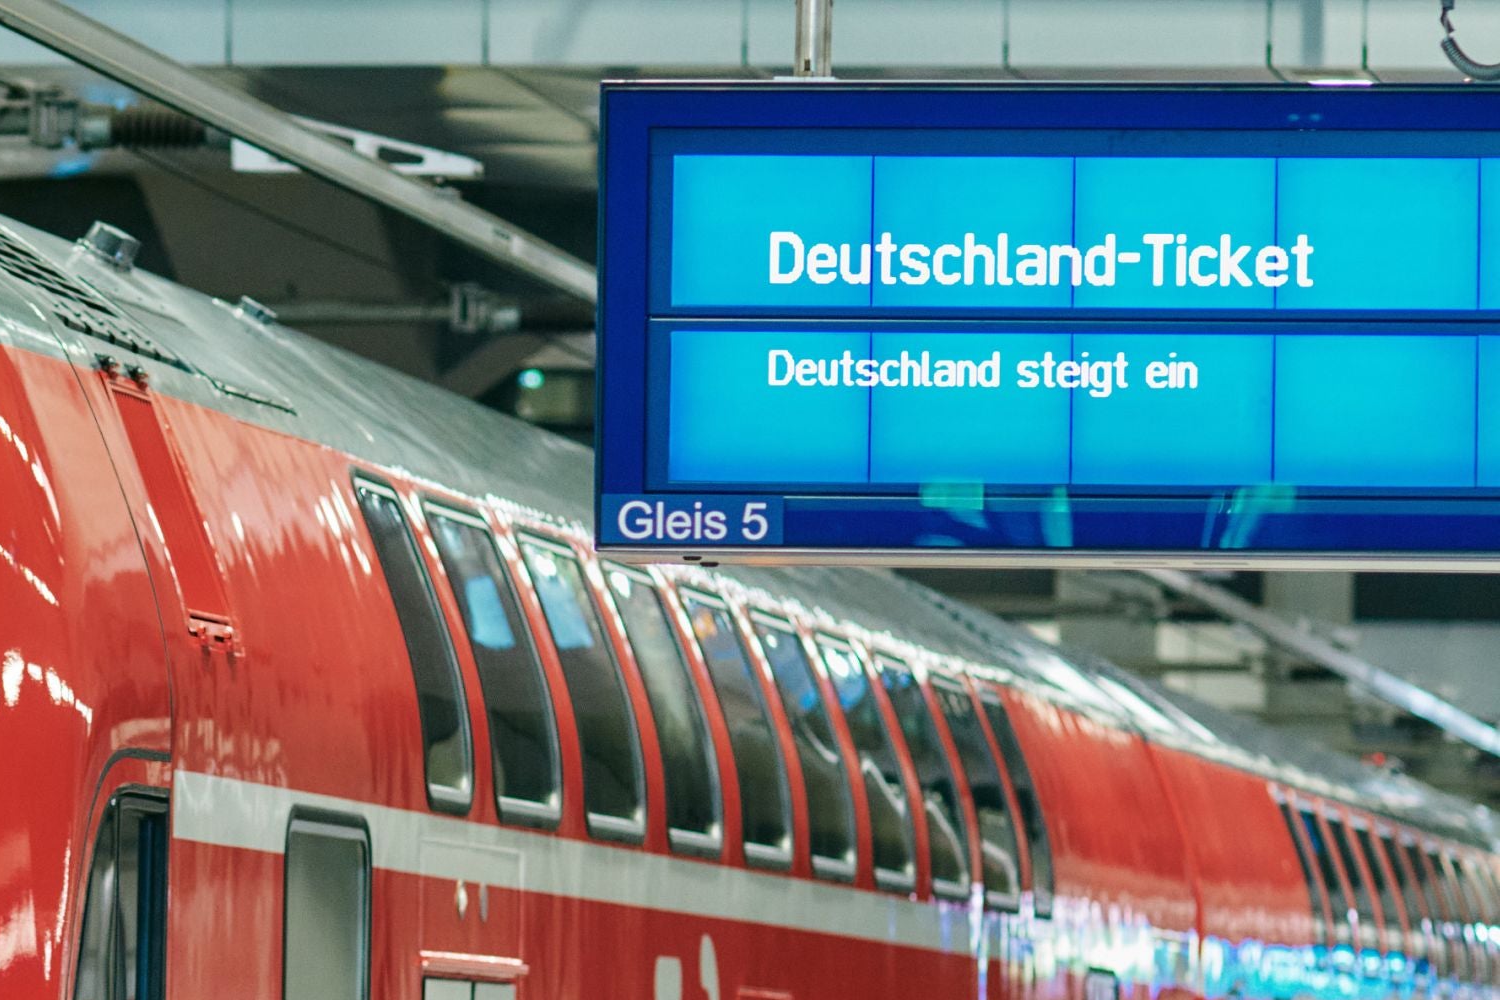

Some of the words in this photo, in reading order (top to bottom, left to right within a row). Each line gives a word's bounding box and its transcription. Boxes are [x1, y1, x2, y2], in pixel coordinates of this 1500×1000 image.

[768, 231, 1315, 288] Deutschland-Ticket
[767, 349, 1001, 388] Deutschland
[1016, 351, 1129, 398] steigt
[1144, 352, 1199, 389] ein
[617, 500, 729, 540] Gleis
[741, 502, 769, 541] 5
